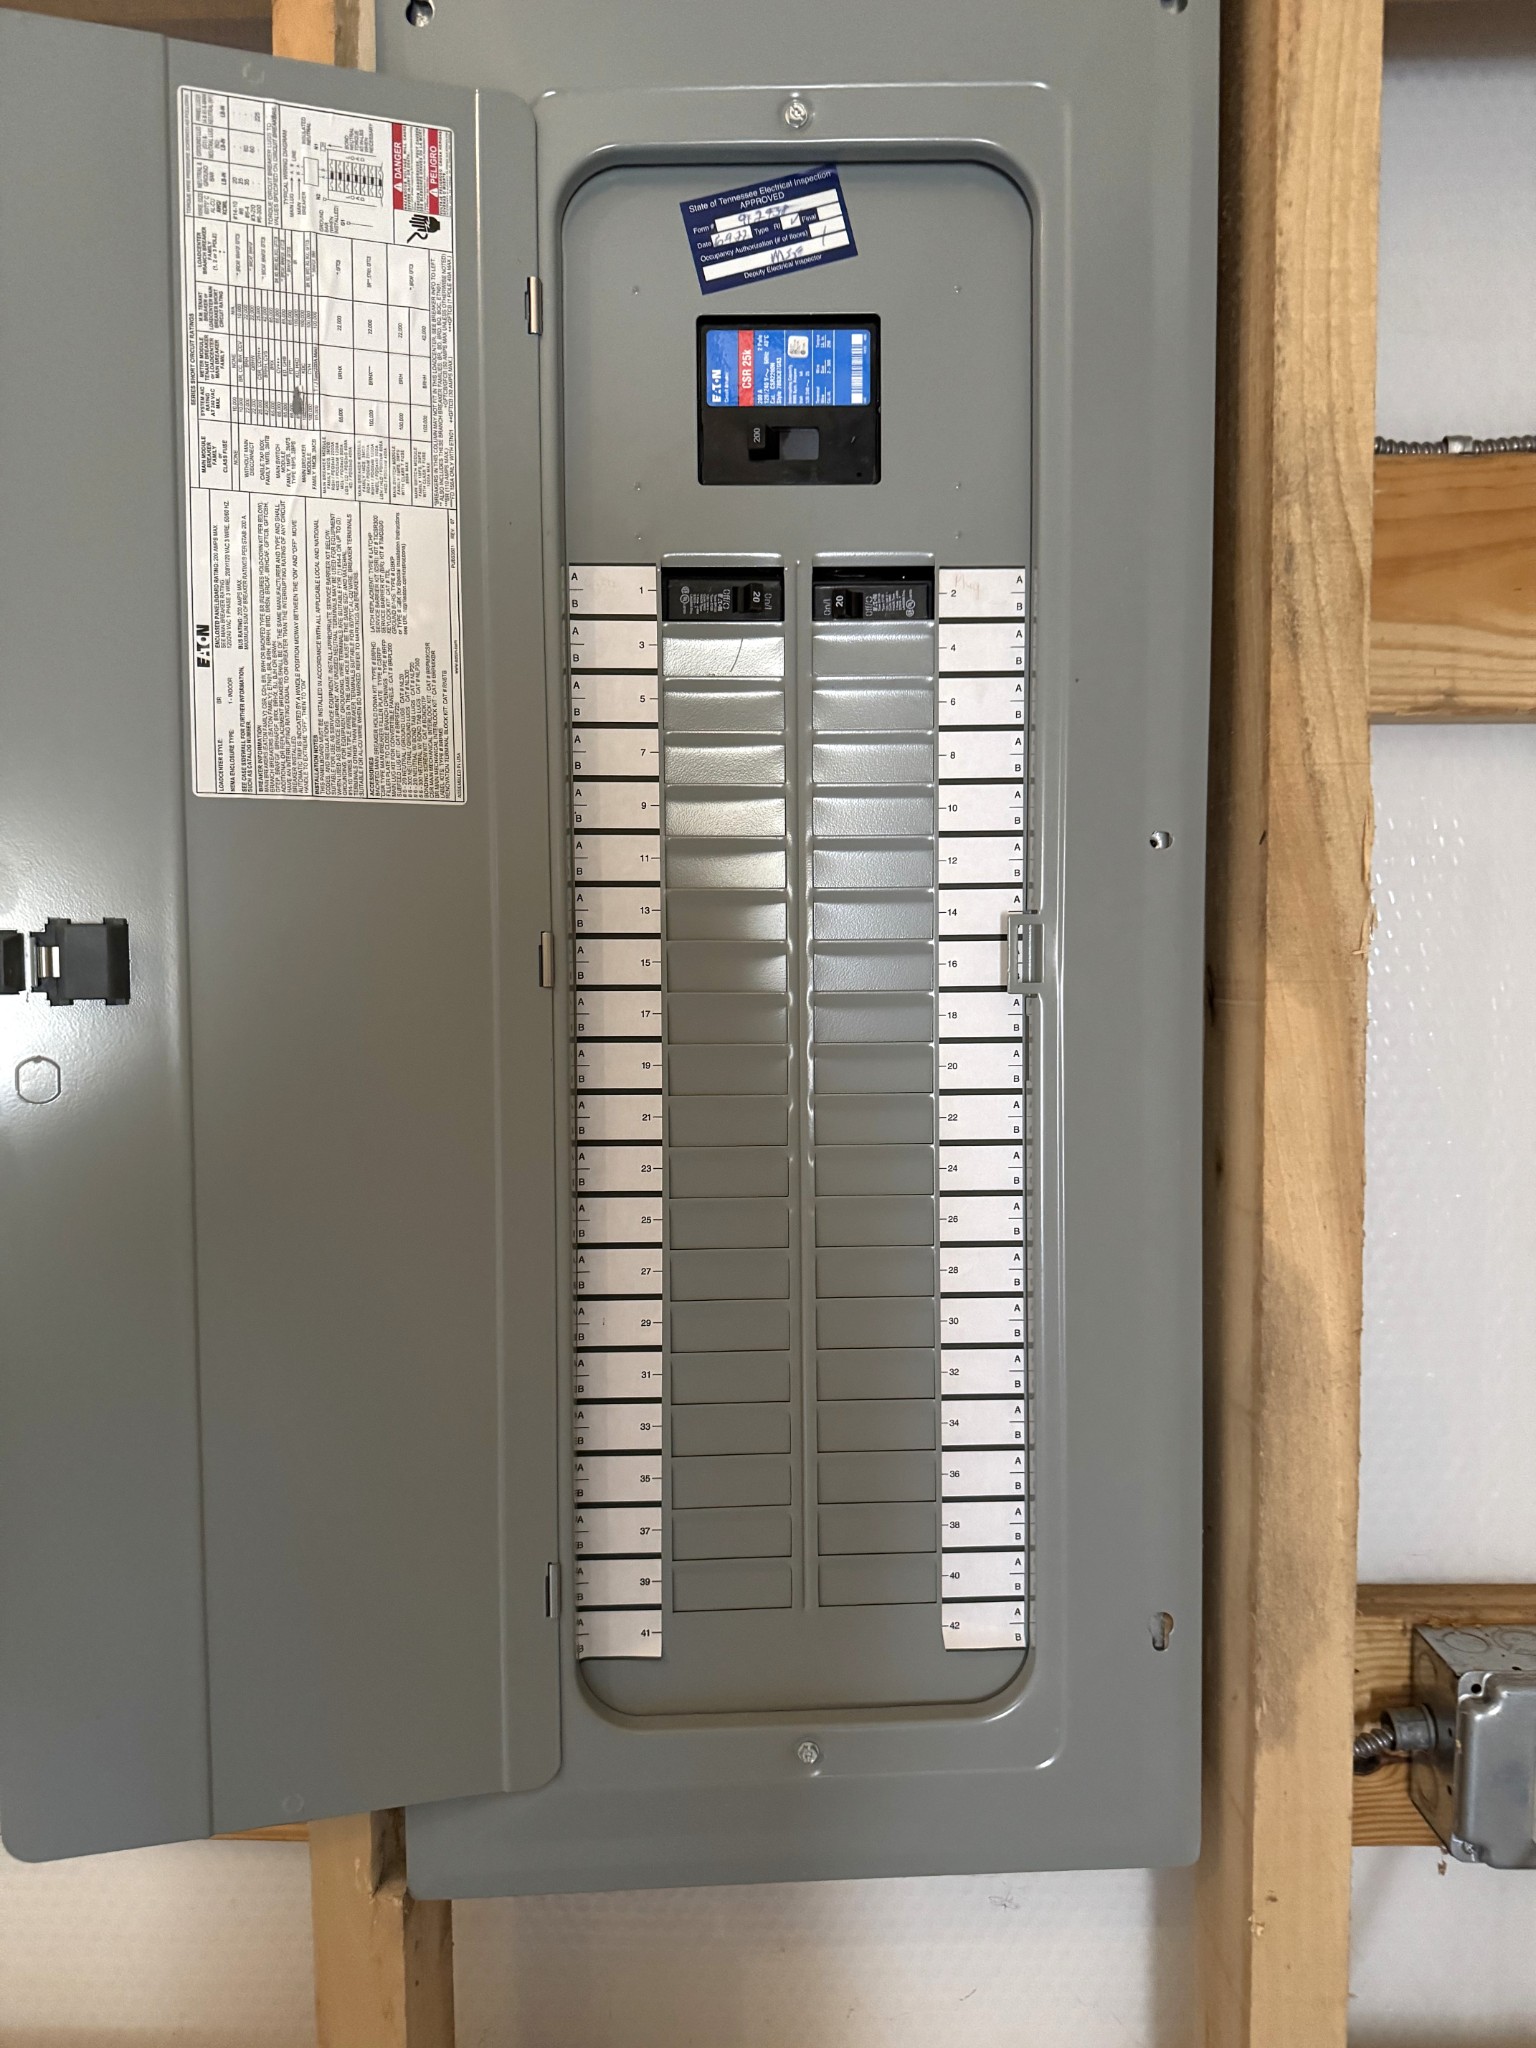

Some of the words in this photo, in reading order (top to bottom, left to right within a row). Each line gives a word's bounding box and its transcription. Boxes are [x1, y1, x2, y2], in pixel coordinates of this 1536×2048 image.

[394, 142, 402, 179] DANGER
[430, 145, 438, 185] PELIGRO
[688, 202, 708, 213] State
[710, 199, 717, 208] of
[718, 191, 758, 206] Tennessee
[759, 181, 792, 195] Electrical
[794, 171, 831, 186] Inspection
[740, 191, 785, 209] APPROVED
[754, 226, 769, 235] Type
[801, 213, 817, 223] Final
[693, 225, 710, 234] Form
[697, 241, 712, 249] Date
[700, 249, 734, 263] Occupancy
[735, 239, 774, 254] Authorization
[744, 268, 765, 279] Deputy
[766, 260, 794, 273] Electrical
[795, 254, 822, 266] Inspector
[742, 349, 752, 367] 25k
[742, 369, 752, 389] CSR
[711, 369, 722, 403] EATON
[753, 427, 761, 443] 200
[571, 572, 578, 580] A
[640, 586, 643, 594] 1
[752, 591, 761, 603] 20
[572, 600, 578, 608] B
[835, 595, 844, 608] 20
[1017, 602, 1022, 610] B
[196, 624, 210, 668] EATON
[573, 681, 580, 689] A
[1016, 684, 1022, 692] A
[951, 698, 955, 706] 6
[574, 708, 580, 716] B
[948, 804, 957, 812] 10
[576, 814, 582, 822] B
[576, 894, 584, 902] A
[948, 908, 957, 916] 14
[948, 960, 957, 968] 16
[641, 1010, 650, 1018] 17
[1014, 1202, 1020, 1210] A
[641, 1216, 651, 1224] 25
[948, 1266, 958, 1274] 28
[1014, 1304, 1020, 1312] A
[1014, 1329, 1020, 1337] B
[949, 1368, 959, 1376] 32
[1014, 1406, 1021, 1414] A
[950, 1470, 960, 1478] 36
[640, 1527, 650, 1535] 37
[640, 1578, 650, 1586] 39
[641, 1629, 650, 1637] 41
[1015, 1633, 1021, 1641] B
